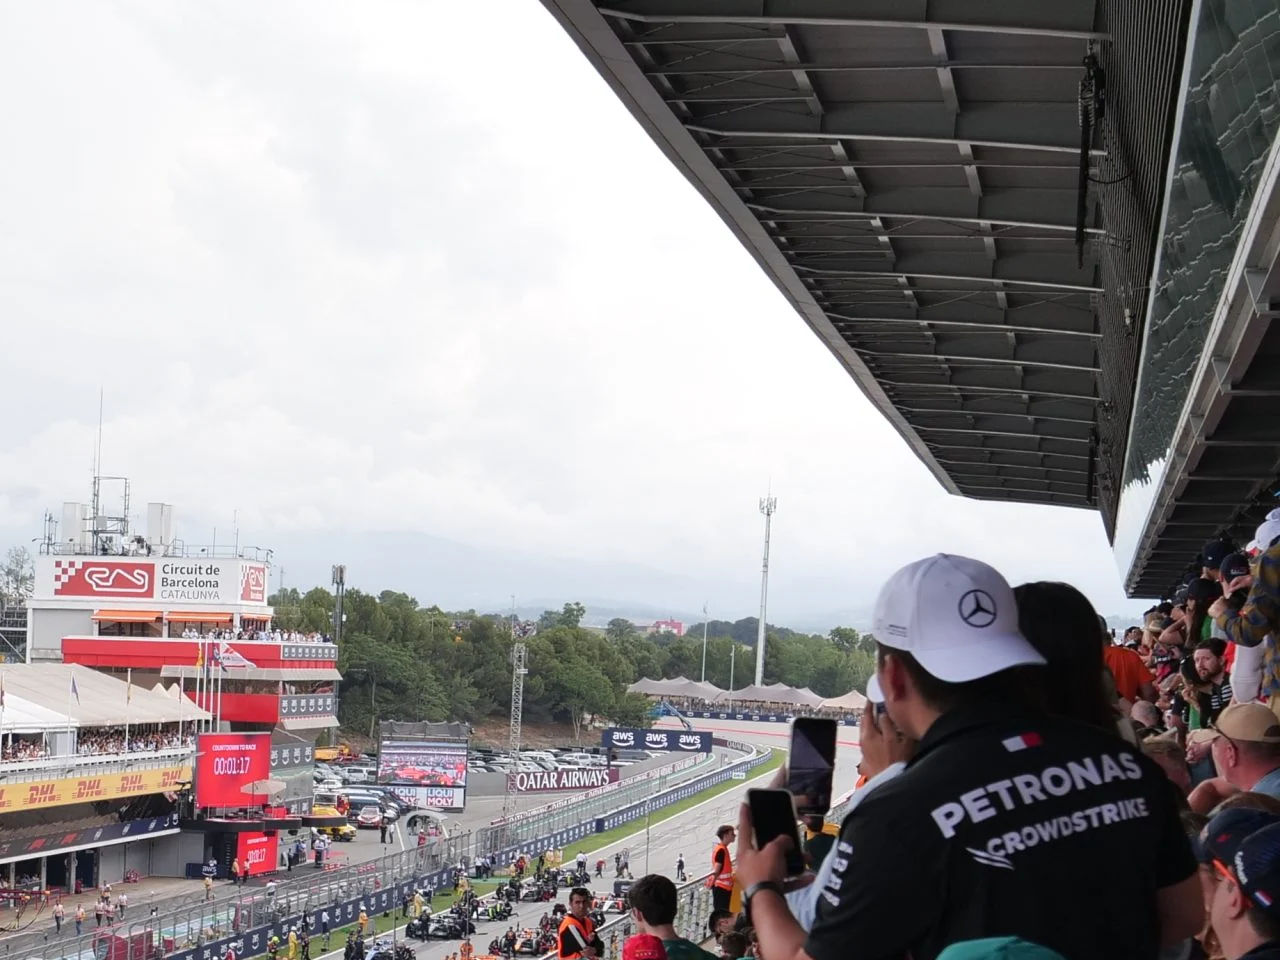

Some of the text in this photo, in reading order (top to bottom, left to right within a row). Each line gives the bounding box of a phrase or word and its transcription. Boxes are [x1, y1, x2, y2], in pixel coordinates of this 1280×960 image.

[162, 563, 220, 576] Circuit de
[161, 577, 219, 588] Barcelona
[161, 589, 220, 600] CATALUNYA
[612, 731, 634, 741] aws
[645, 733, 668, 743] aws
[679, 734, 701, 744] aws
[214, 757, 250, 775] 00:01:17
[121, 774, 144, 793] DHL
[517, 771, 558, 791] QATAR
[560, 769, 610, 788] AIRWAYS
[28, 783, 56, 805] DHL
[77, 778, 103, 799] DHL
[427, 788, 454, 797] LIQUI
[427, 797, 454, 807] MOLY
[931, 752, 1144, 839] PETRONAS
[985, 797, 1150, 859] CROWDSTRIKE
